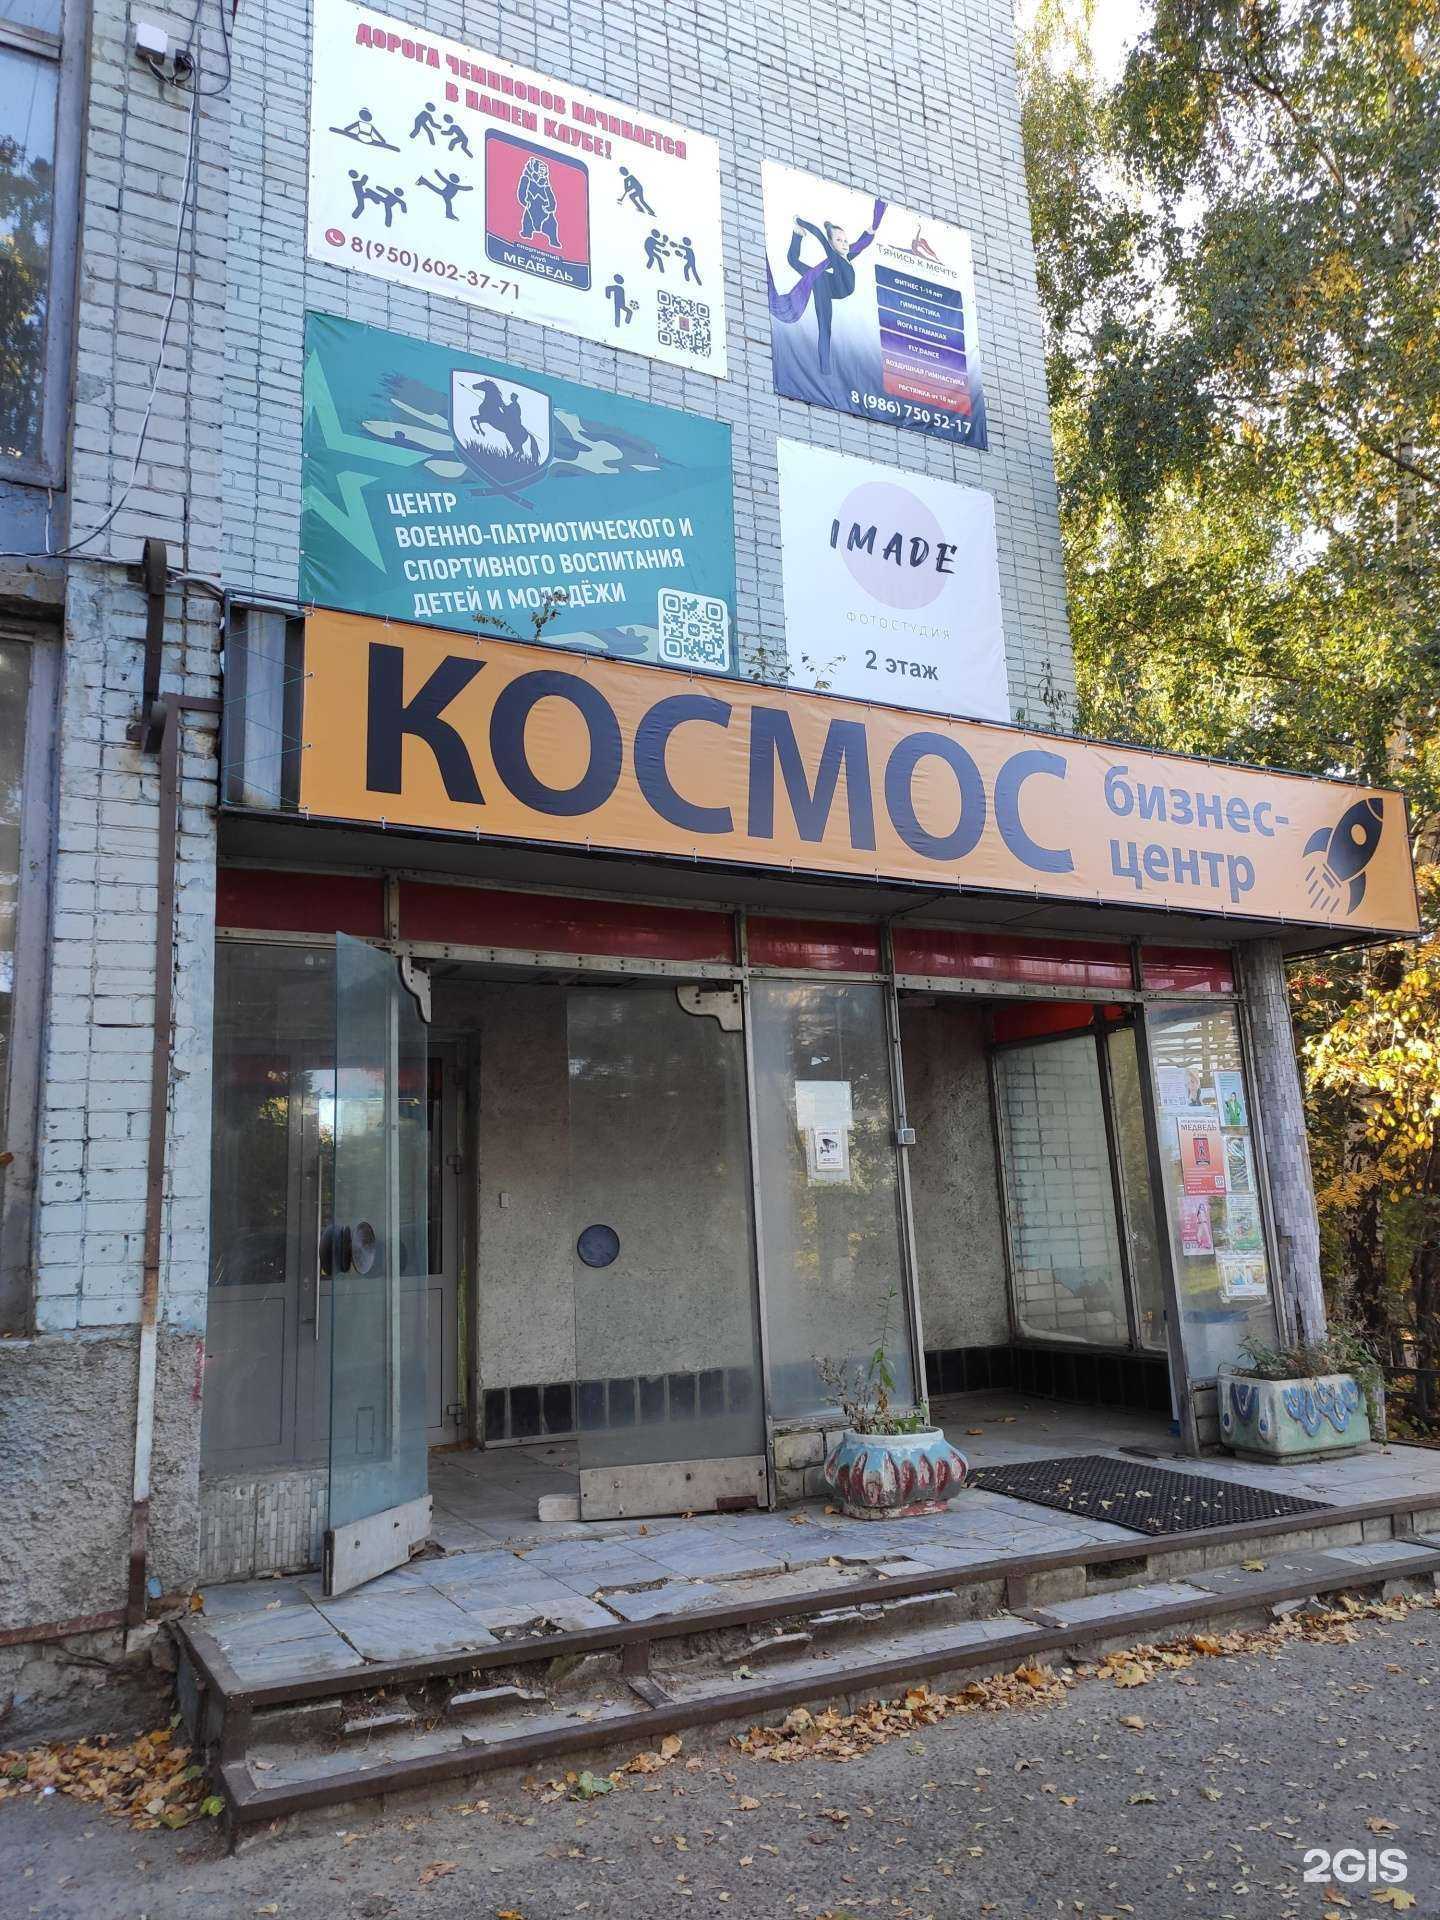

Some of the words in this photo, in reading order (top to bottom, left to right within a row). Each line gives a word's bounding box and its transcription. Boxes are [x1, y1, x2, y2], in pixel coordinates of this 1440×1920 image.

[355, 23, 440, 69] ДОРОГА
[446, 53, 566, 115] ЧЕМПИОНОВ
[572, 101, 687, 160] НАЧИНАЕТСЯ
[445, 81, 459, 102] В
[465, 88, 538, 132] НАШЕМ
[543, 117, 612, 160] КЛУБЕ!
[351, 236, 519, 299] 8(950)602-37-71
[503, 251, 573, 281] МЕДВЕДЬ
[894, 278, 919, 291] ФИТНЕС
[900, 300, 941, 318] ГИМНАСТИКА
[896, 319, 914, 331] ЙОГА
[918, 327, 947, 340] ГАМАКАХ
[908, 344, 919, 353] FLY
[920, 348, 940, 360] DANCE
[885, 358, 925, 375] ВОЗДУШНАЯ
[924, 368, 966, 386] ГИМНАСТИКА
[851, 390, 859, 404] 8
[863, 393, 900, 416] (986)
[904, 404, 931, 423] 750
[934, 413, 971, 434] 52-17
[386, 493, 457, 518] ЦЕНТР
[395, 518, 675, 548] ВОЕННО-ПАТРИОТИЧЕСКОГО
[678, 517, 694, 537] И
[403, 553, 555, 582] СПОРТИВНОГО
[560, 548, 685, 574] ВОСПИТАНИЯ
[413, 585, 483, 618] ДЕТЕЙ
[486, 589, 503, 610] И
[846, 611, 950, 640] ФОТОСТУДИЯ
[865, 649, 878, 670] 2
[885, 657, 940, 681] этаж
[366, 642, 1074, 873] КОСМОС
[1104, 765, 1289, 838] бизнес-
[1110, 838, 1256, 903] центр
